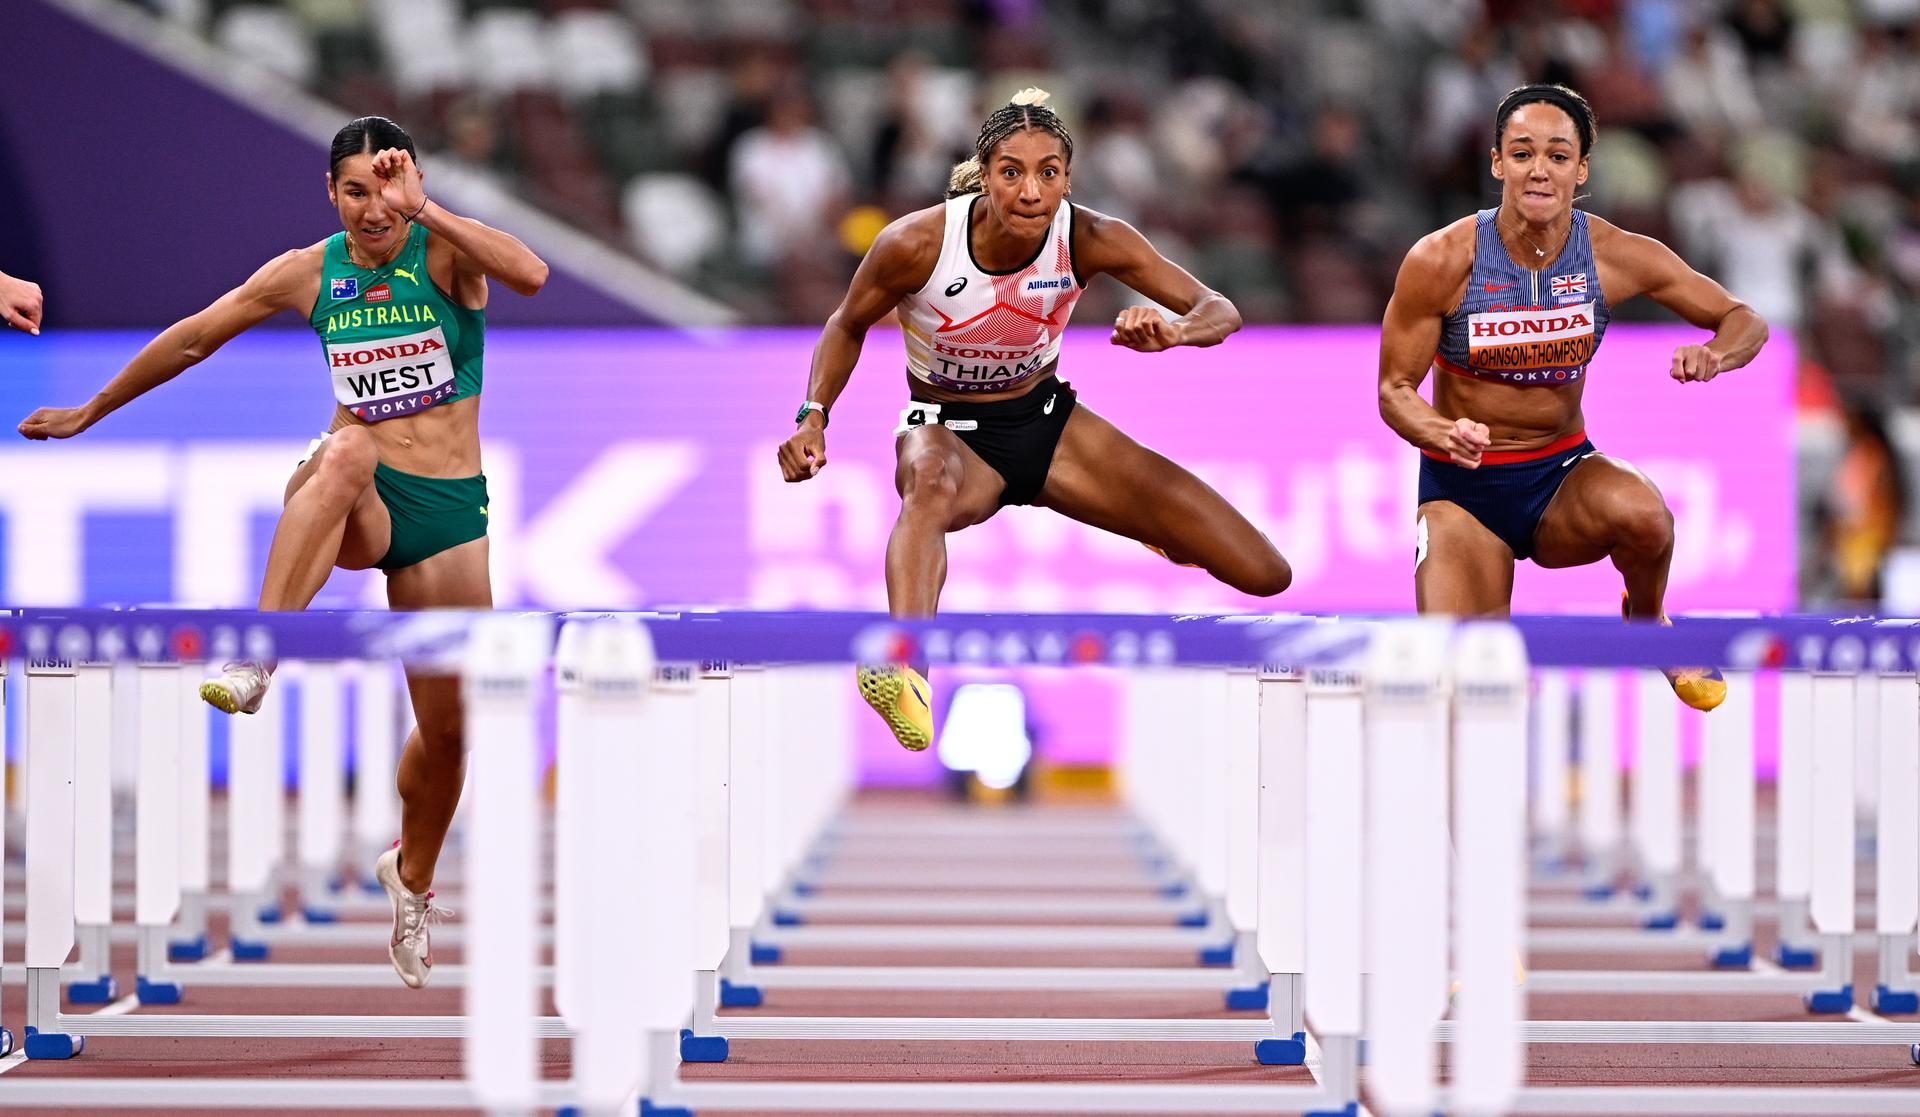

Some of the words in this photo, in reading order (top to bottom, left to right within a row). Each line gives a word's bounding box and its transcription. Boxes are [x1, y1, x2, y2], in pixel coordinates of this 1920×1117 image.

[1027, 280, 1059, 290] Allianz
[326, 304, 436, 334] AUSTRALIA
[1471, 313, 1592, 337] HONDA
[331, 338, 445, 367] HONDA
[1473, 336, 1591, 367] JOHNSON-THOMPSON
[347, 361, 436, 398] WEST
[936, 354, 1040, 380] THIAM
[907, 409, 926, 425] 4
